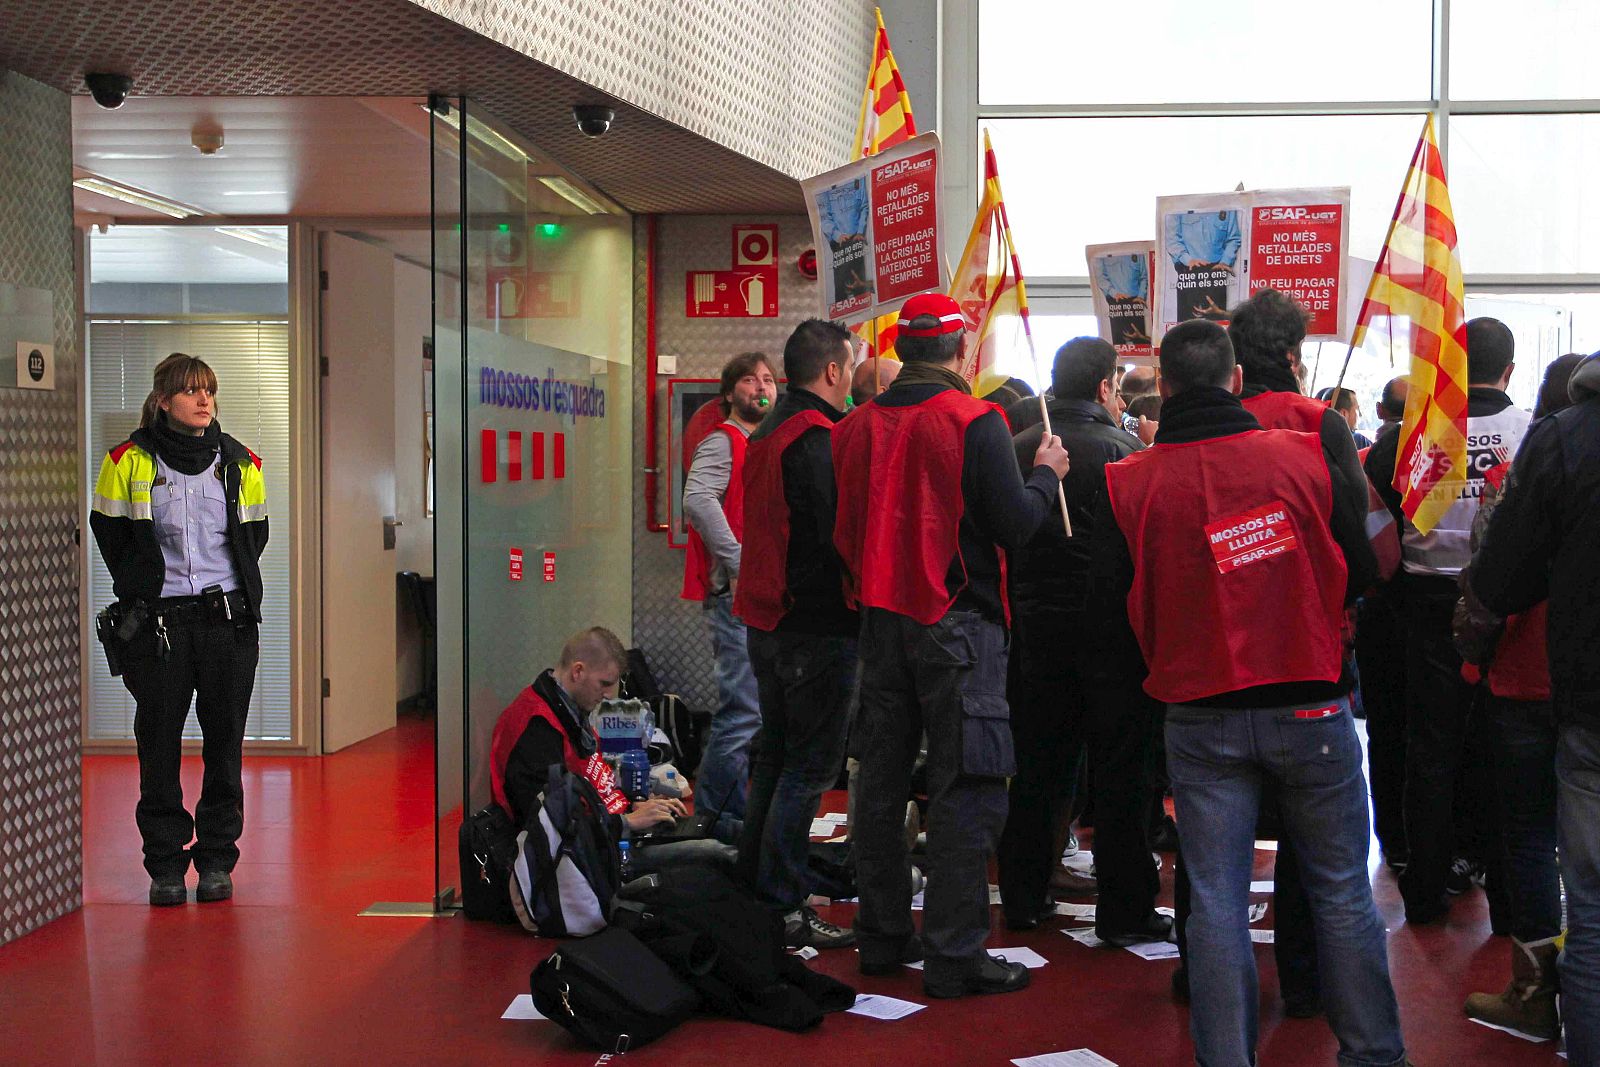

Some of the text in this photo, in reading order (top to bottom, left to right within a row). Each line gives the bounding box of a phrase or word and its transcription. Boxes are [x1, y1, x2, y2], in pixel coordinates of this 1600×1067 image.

[887, 190, 899, 201] NO
[877, 192, 929, 216] RETALLADES
[884, 206, 923, 226] DE DRETS
[875, 228, 934, 253] NO FEU PAGAR
[1273, 232, 1289, 242] NO
[880, 240, 931, 264] LA CRISI ALS
[1258, 243, 1332, 254] RETALLADES
[880, 252, 932, 276] MATEIXOS DE
[1266, 254, 1322, 265] DE DRETS
[890, 267, 923, 285] SEMPRE
[1178, 270, 1227, 281] que no ens
[1177, 280, 1197, 291] quin
[1199, 279, 1212, 288] els
[1251, 278, 1335, 289] NO FEU PAGAR
[1279, 289, 1330, 299] RISI ALS
[1110, 303, 1121, 311] que
[1313, 300, 1330, 310] DE
[480, 366, 605, 424] mossos d'esquadra
[1210, 511, 1285, 544] MOSSOS EN
[1228, 528, 1276, 551] LLUITA
[602, 715, 637, 730] Ribes
